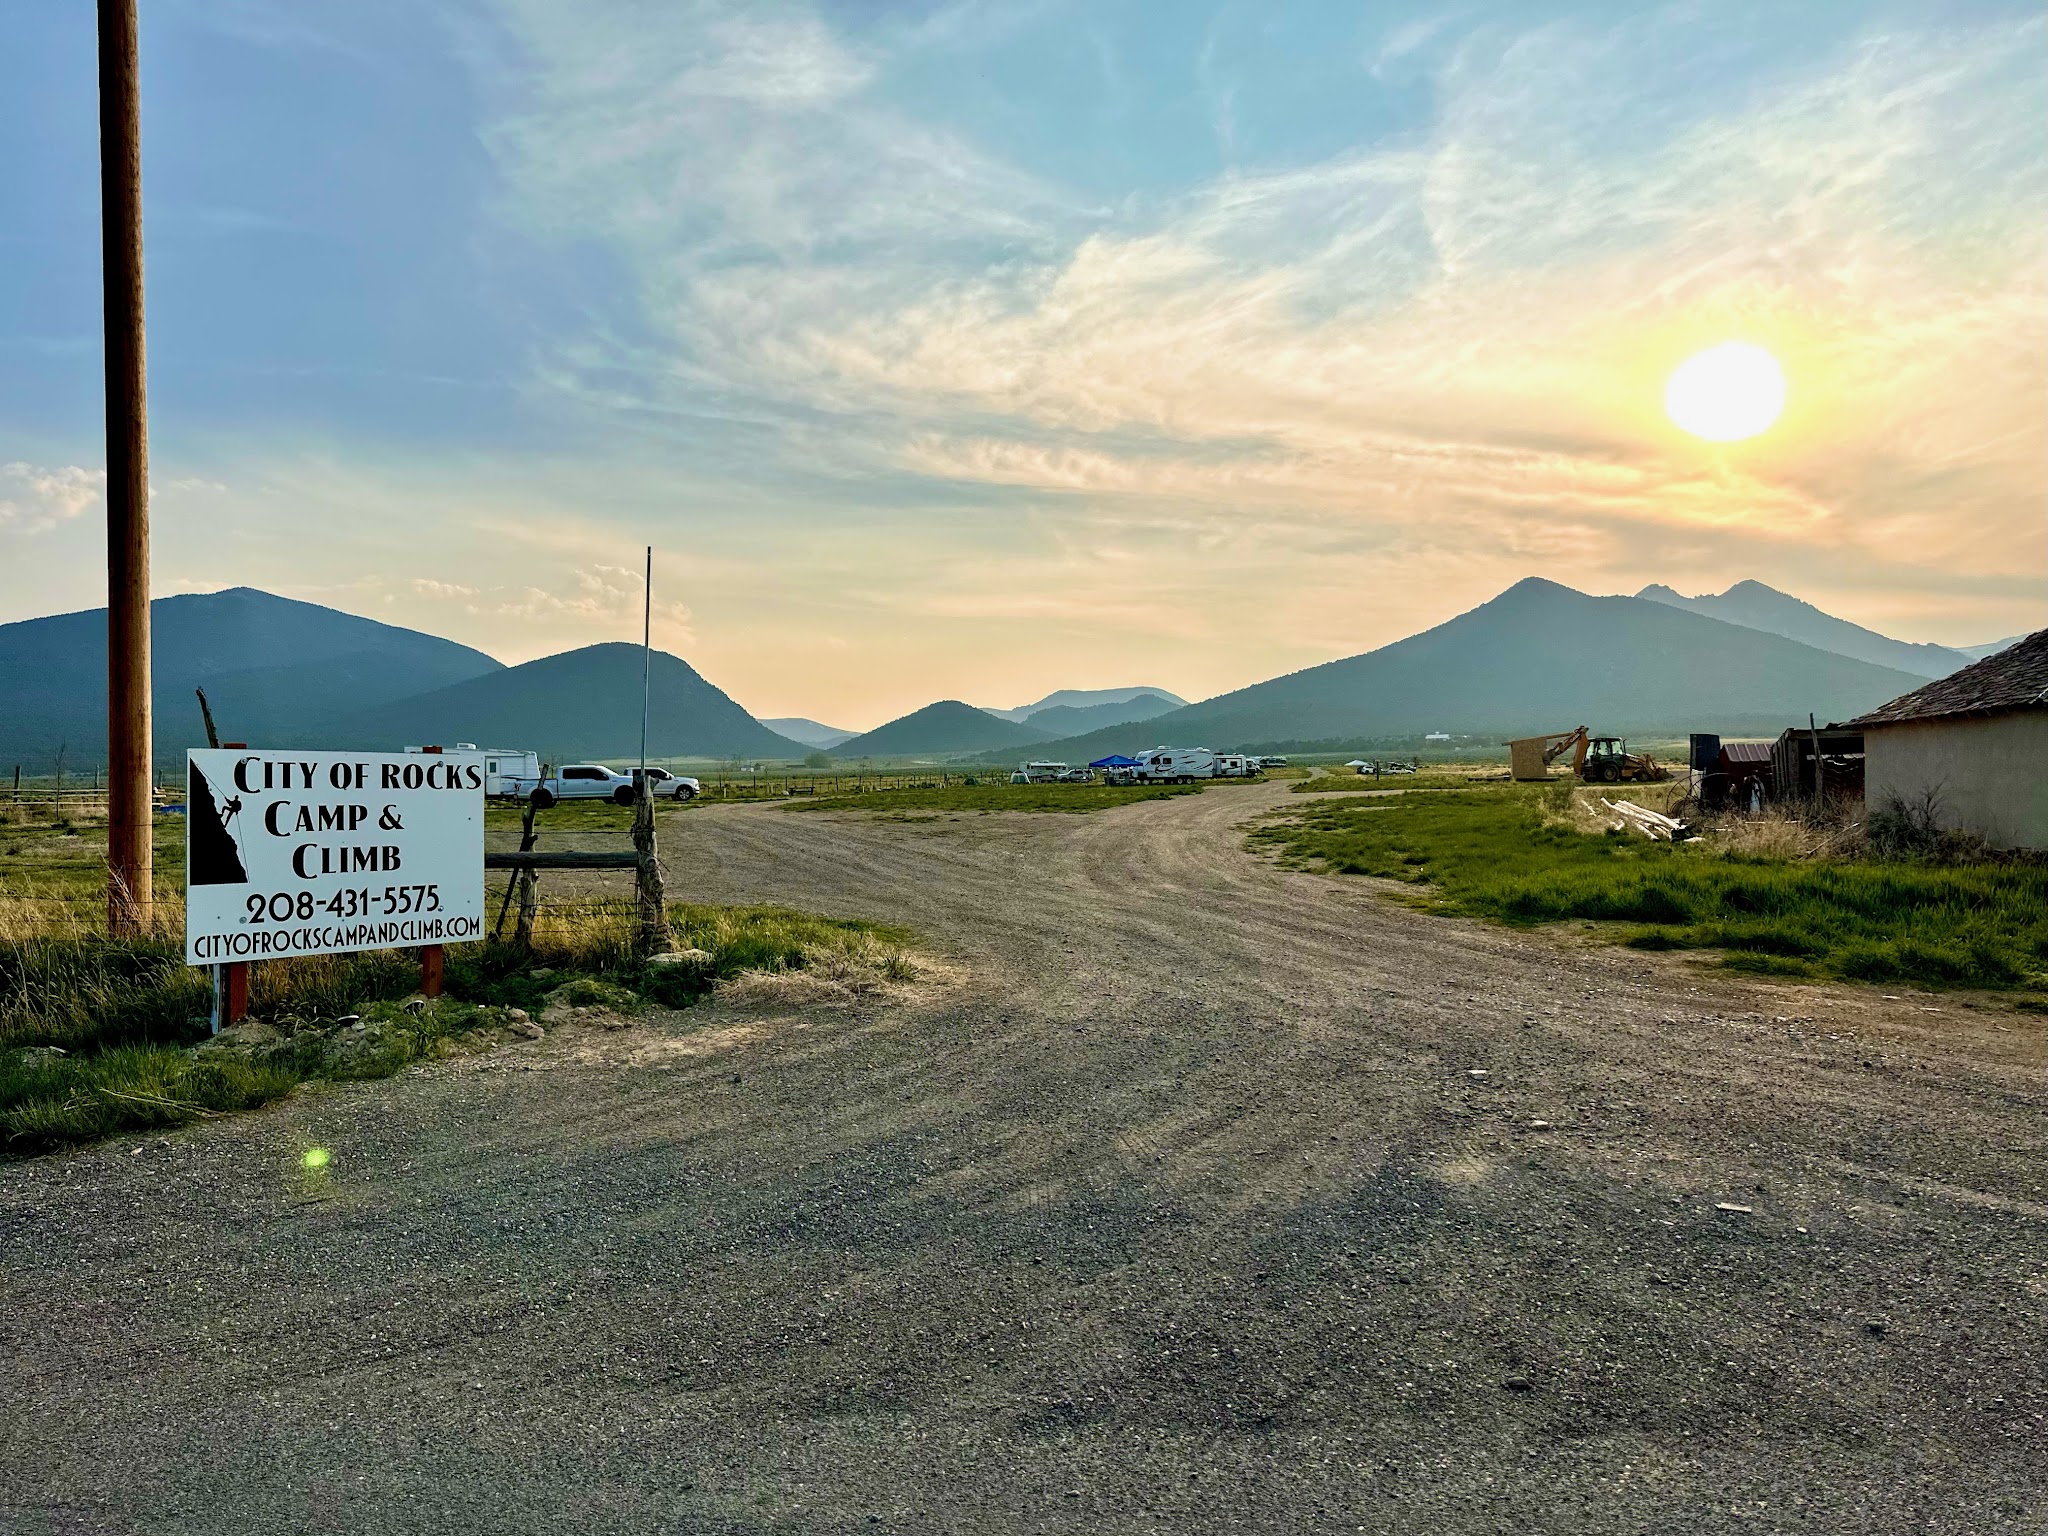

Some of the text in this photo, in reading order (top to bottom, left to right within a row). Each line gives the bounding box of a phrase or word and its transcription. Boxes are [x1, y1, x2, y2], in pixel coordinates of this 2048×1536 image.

[234, 756, 482, 794] CITY OF ROCKS
[264, 800, 405, 837] CAMP &
[292, 843, 402, 880] CLIMB
[246, 884, 440, 924] 208-431-5575
[194, 916, 480, 958] CITYOFROCKSCAMPANDCLIMB.COM
